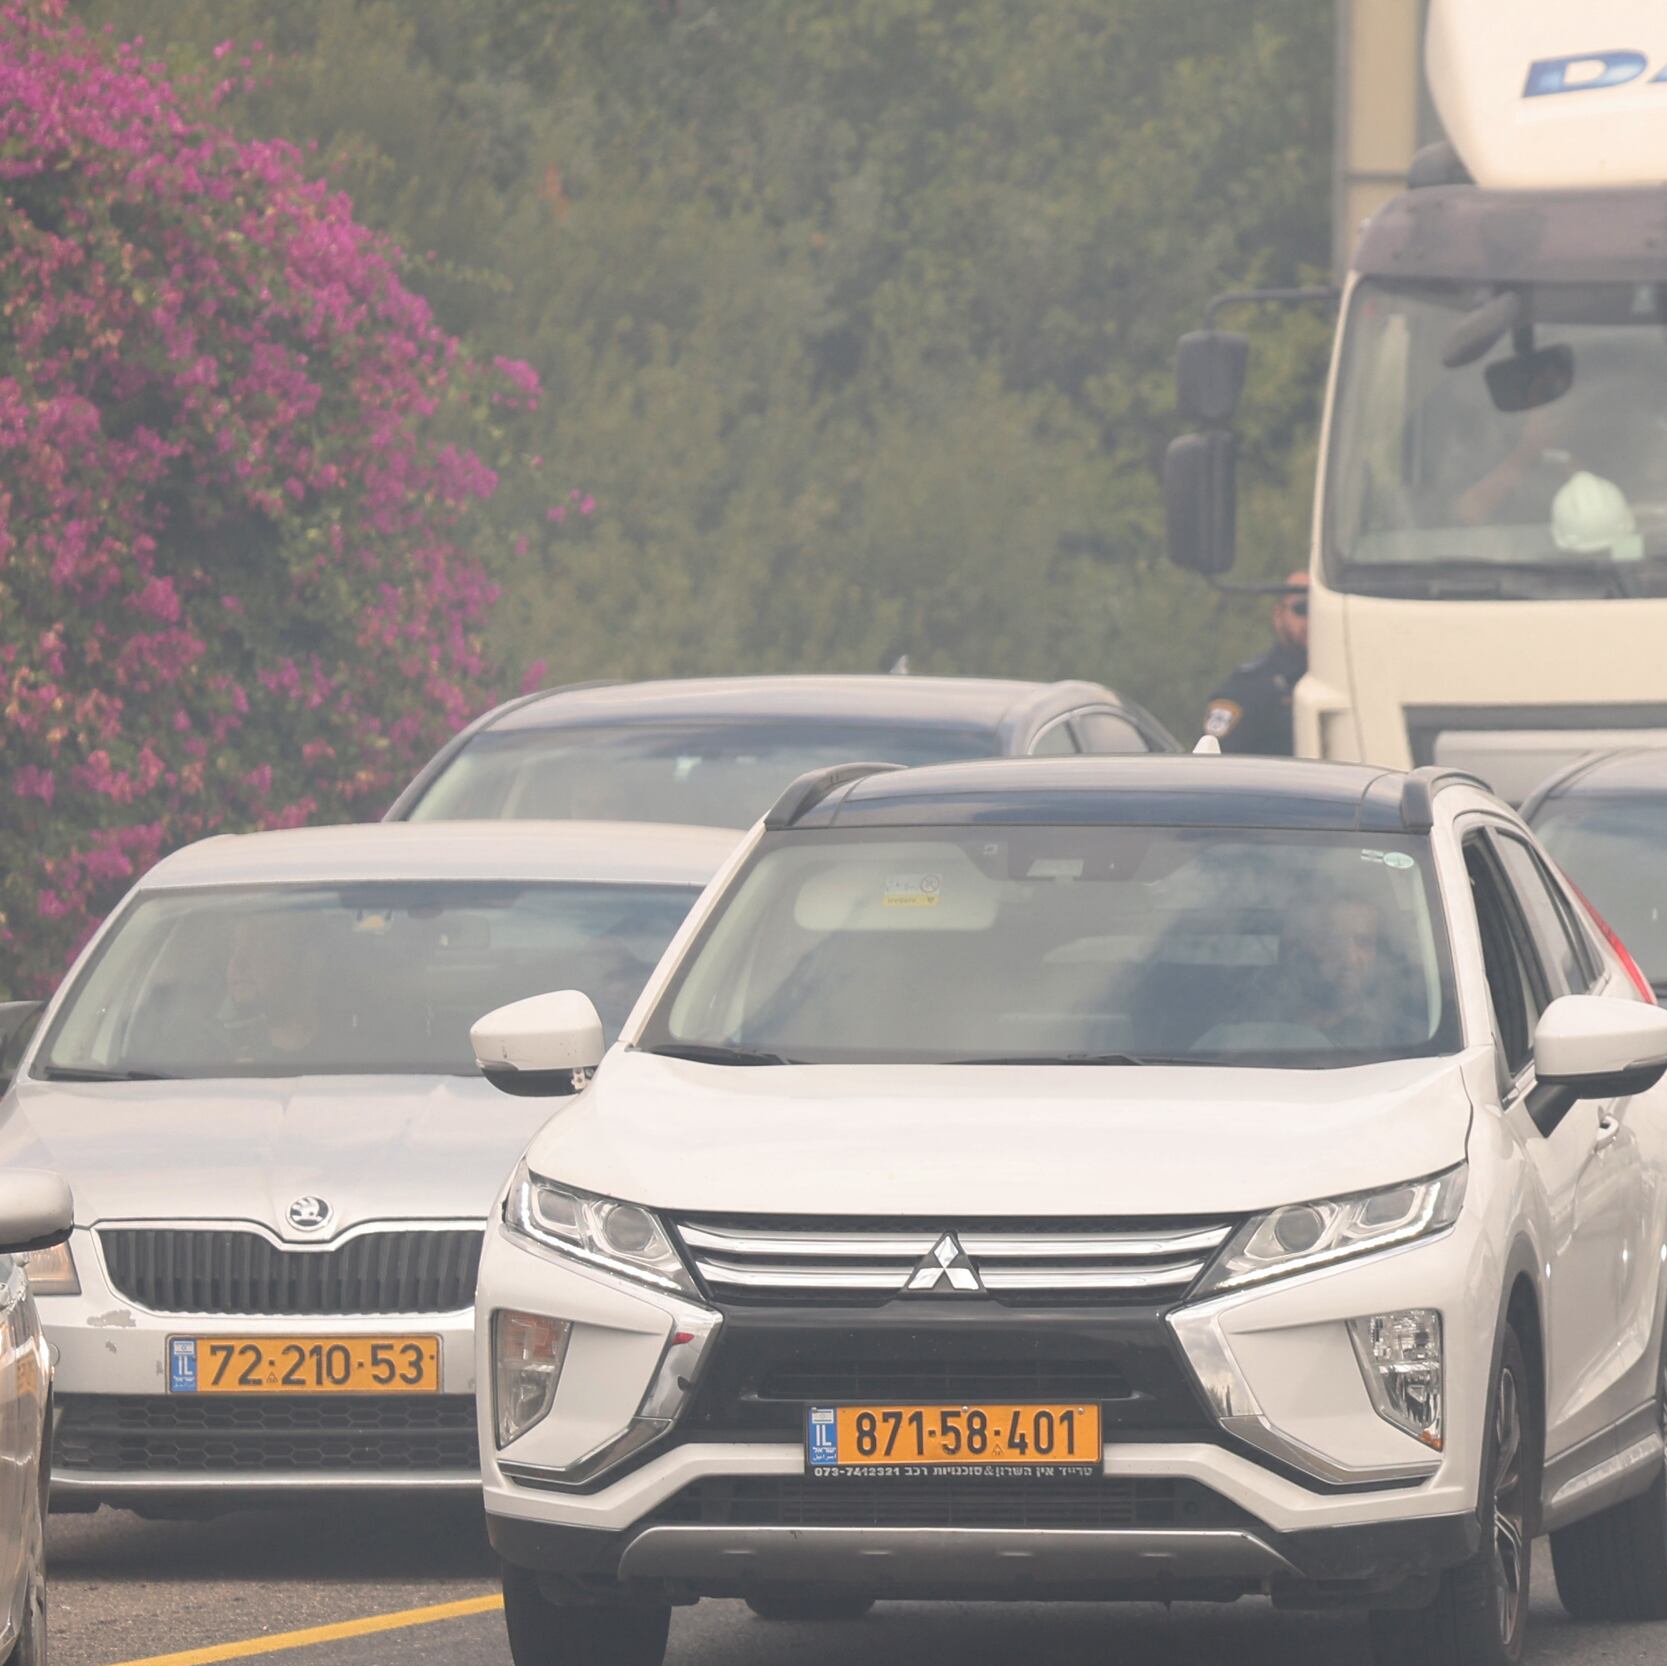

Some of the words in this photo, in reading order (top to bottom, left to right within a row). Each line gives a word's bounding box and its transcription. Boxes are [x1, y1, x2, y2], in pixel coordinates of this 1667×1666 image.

[178, 1354, 193, 1376] IL
[816, 1424, 832, 1446] IL
[814, 1466, 900, 1477] 073-7412321
[904, 1466, 929, 1477] רכב
[1035, 1466, 1055, 1478] אין
